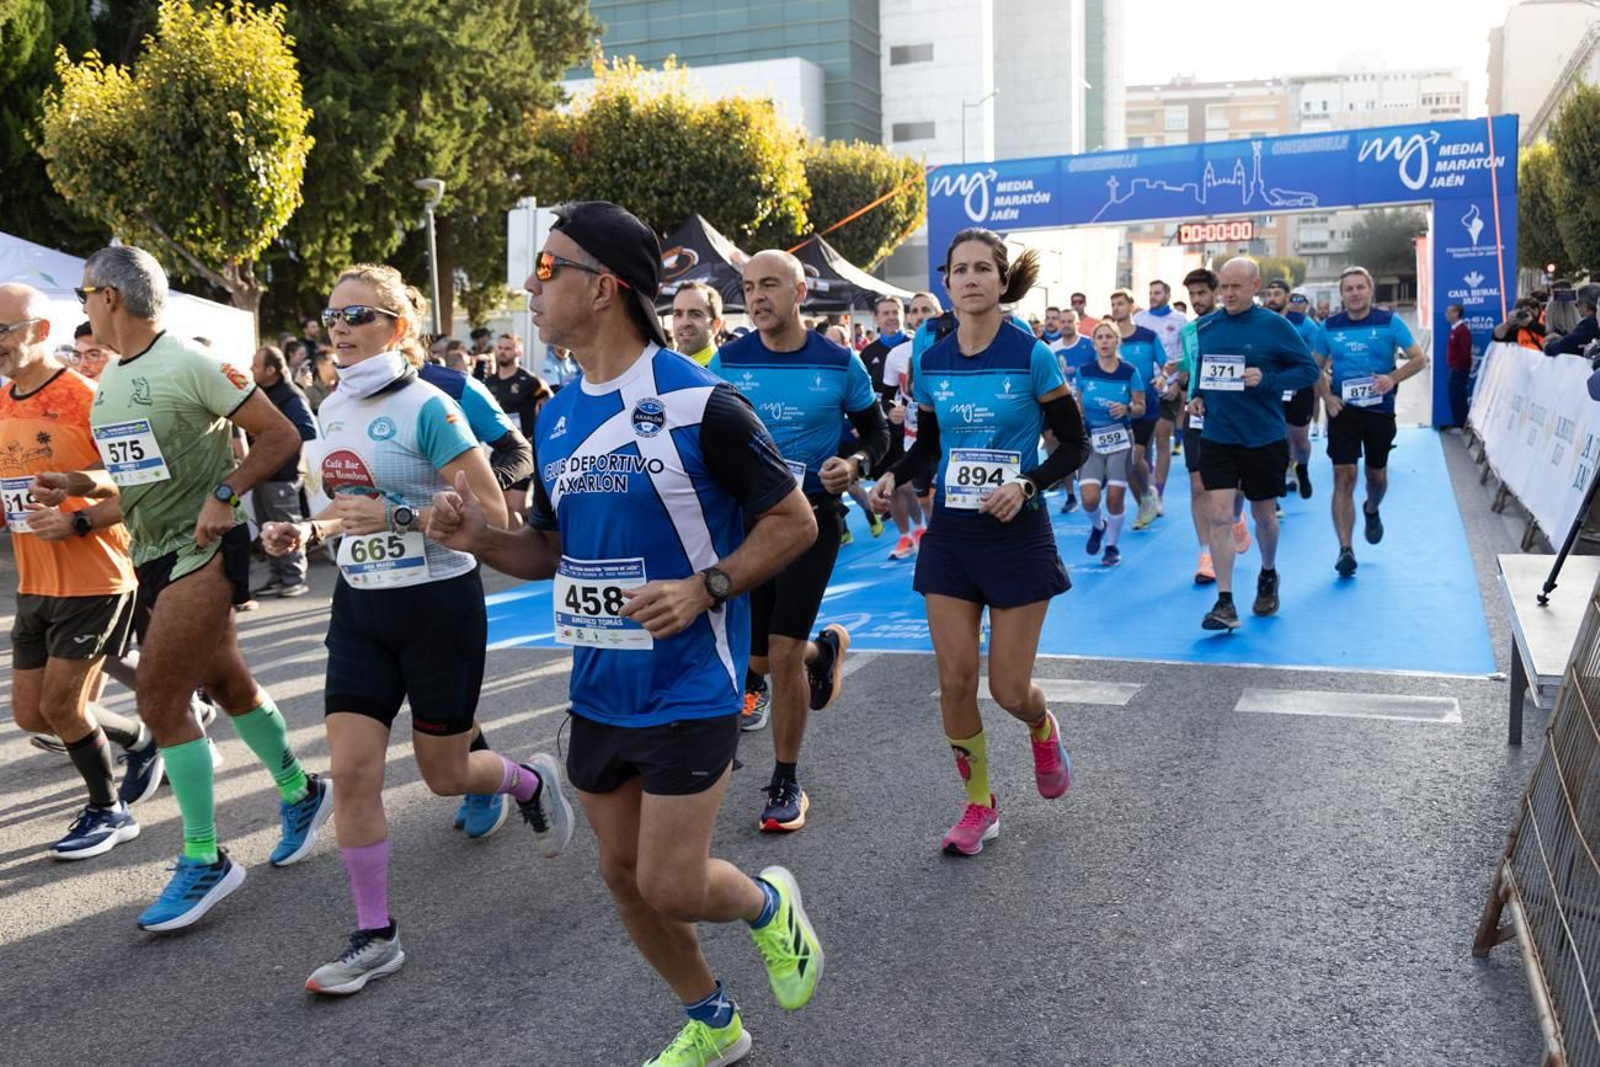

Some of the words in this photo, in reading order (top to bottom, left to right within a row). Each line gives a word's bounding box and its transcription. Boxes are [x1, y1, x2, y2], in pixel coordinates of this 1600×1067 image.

[1439, 142, 1484, 157] MEDIA
[1435, 155, 1506, 172] MARATÓN
[996, 180, 1034, 192] MEDIA
[1429, 174, 1466, 188] JAÉN
[994, 191, 1051, 207] MARATÓN
[990, 208, 1019, 221] JAÉN
[1180, 222, 1252, 243] 00:00:00
[1210, 364, 1235, 378] 371
[108, 440, 144, 463] 575
[345, 460, 360, 469] Bar
[544, 459, 567, 481] CLUB
[570, 454, 664, 475] DEPORTIVO
[558, 471, 628, 494] AXARLÓN
[957, 465, 1005, 487] 894
[351, 535, 405, 563] 665
[565, 584, 624, 616] 458
[599, 618, 623, 626] TOMÁS
